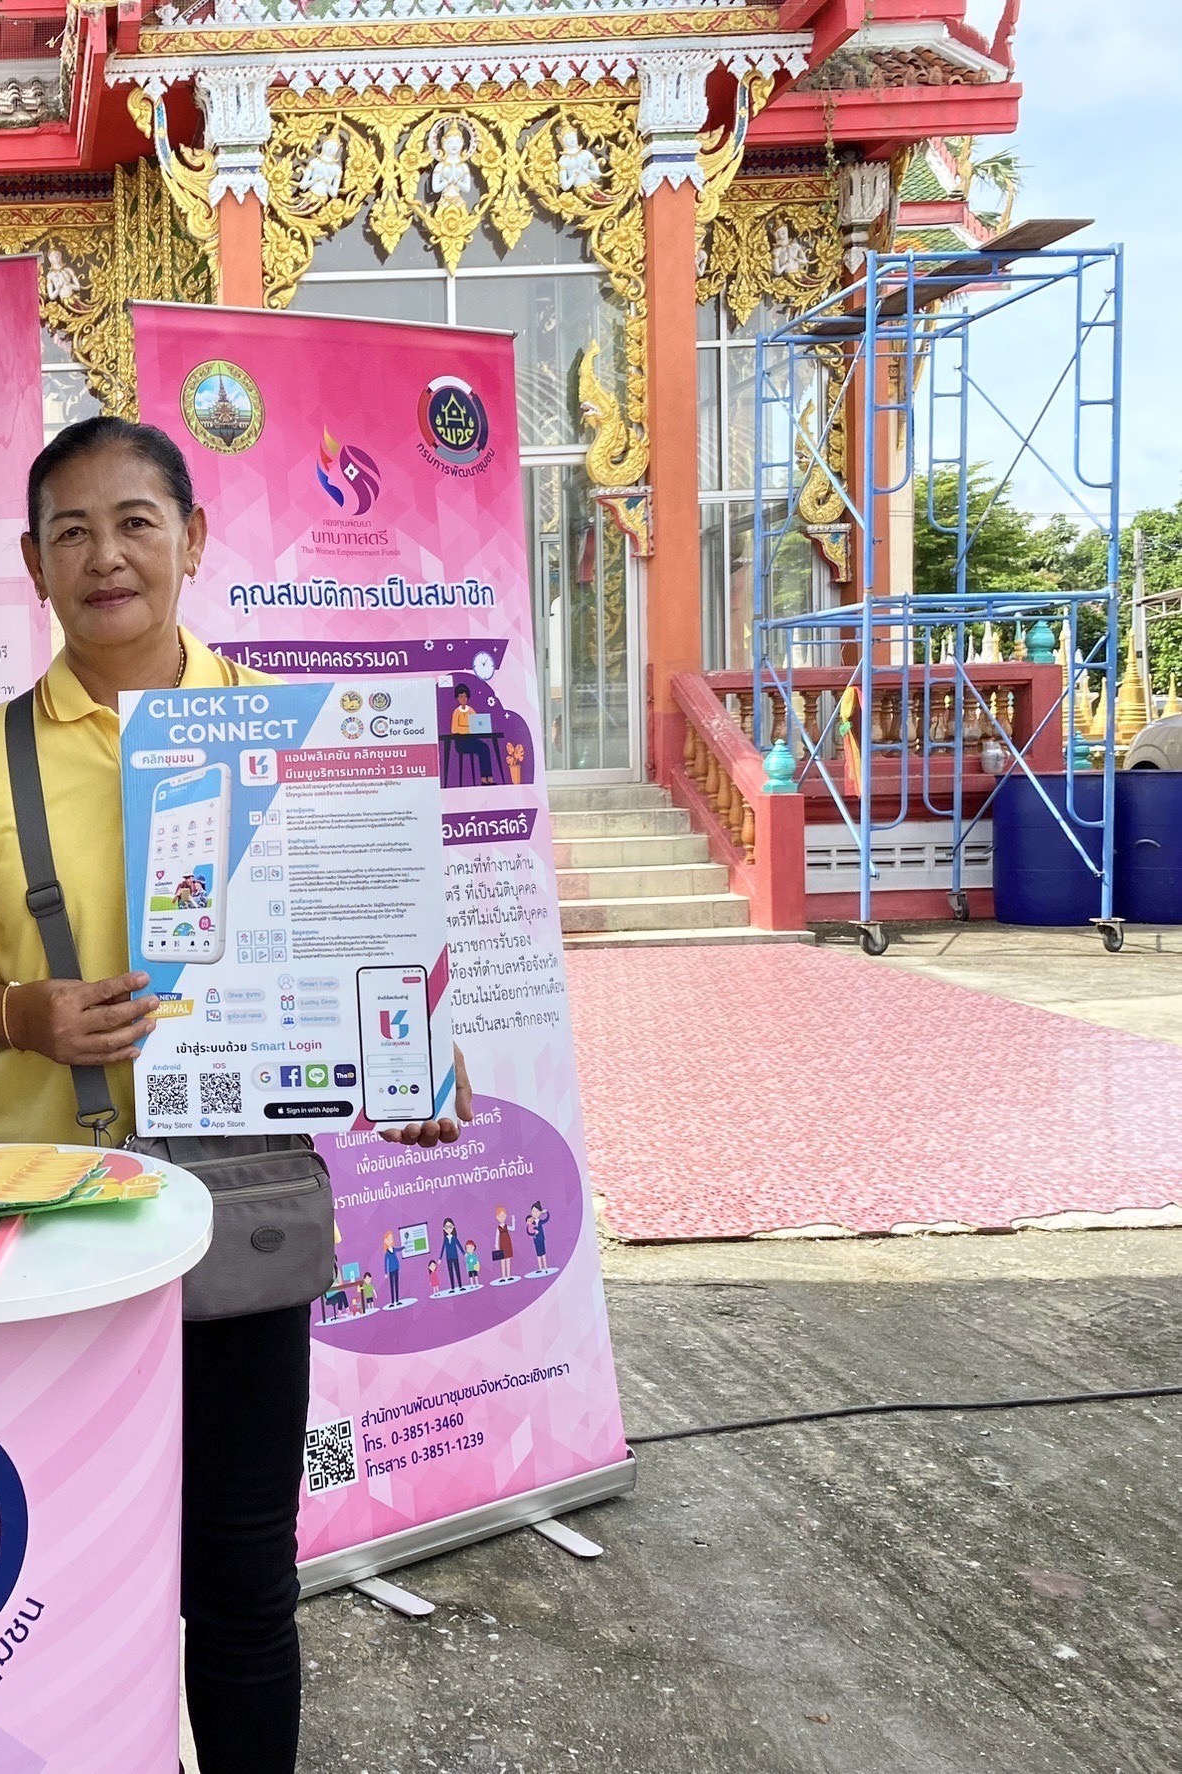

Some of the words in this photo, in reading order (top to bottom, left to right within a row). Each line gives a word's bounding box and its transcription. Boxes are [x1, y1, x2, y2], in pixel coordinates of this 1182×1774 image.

[416, 448, 495, 478] กรมการพัฒนาชุมชน
[311, 529, 389, 546] บทบาทสตรี
[229, 578, 495, 616] คุณสมบัติการเป็นสมาชิก
[236, 646, 408, 672] ประเภทบุคคลธรรมดา
[148, 696, 227, 719] CLICK
[232, 693, 269, 715] TO
[169, 718, 298, 744] CONNECT
[389, 728, 402, 736] for
[403, 727, 425, 736] Good
[142, 753, 195, 767] คลิกชุมชน
[284, 750, 351, 763] แอปพลิเคชัน
[354, 749, 407, 762] คลิกชุมชน
[285, 764, 386, 781] มีเมนูบริการมากกว่า
[390, 765, 404, 775] 13
[406, 765, 427, 777] เมนู
[442, 812, 528, 839] องค์กรสตรี
[159, 993, 178, 1001] NEW
[176, 1041, 247, 1057] เข้าสู่ระบบด้วย
[251, 1041, 286, 1052] Smart
[288, 1040, 322, 1052] Login
[152, 1063, 181, 1071] Android
[286, 1106, 300, 1115] Sign
[308, 1105, 321, 1114] with
[321, 1105, 340, 1115] Apple
[157, 1122, 173, 1130] Play
[174, 1121, 193, 1129] Store
[211, 1121, 226, 1129] App
[226, 1120, 246, 1128] Store
[356, 1138, 485, 1175] เพื่อขับเคลื่อนเศรษฐกิจ
[361, 1362, 570, 1428] สำนักงานพัฒนาชุมชนจังหวัดฉะเชิงเทรา
[363, 1433, 387, 1453] โทร.
[391, 1412, 464, 1446] 0-3851-3460
[365, 1455, 407, 1478] โทรสาร
[411, 1431, 484, 1465] 0-3851-1239
